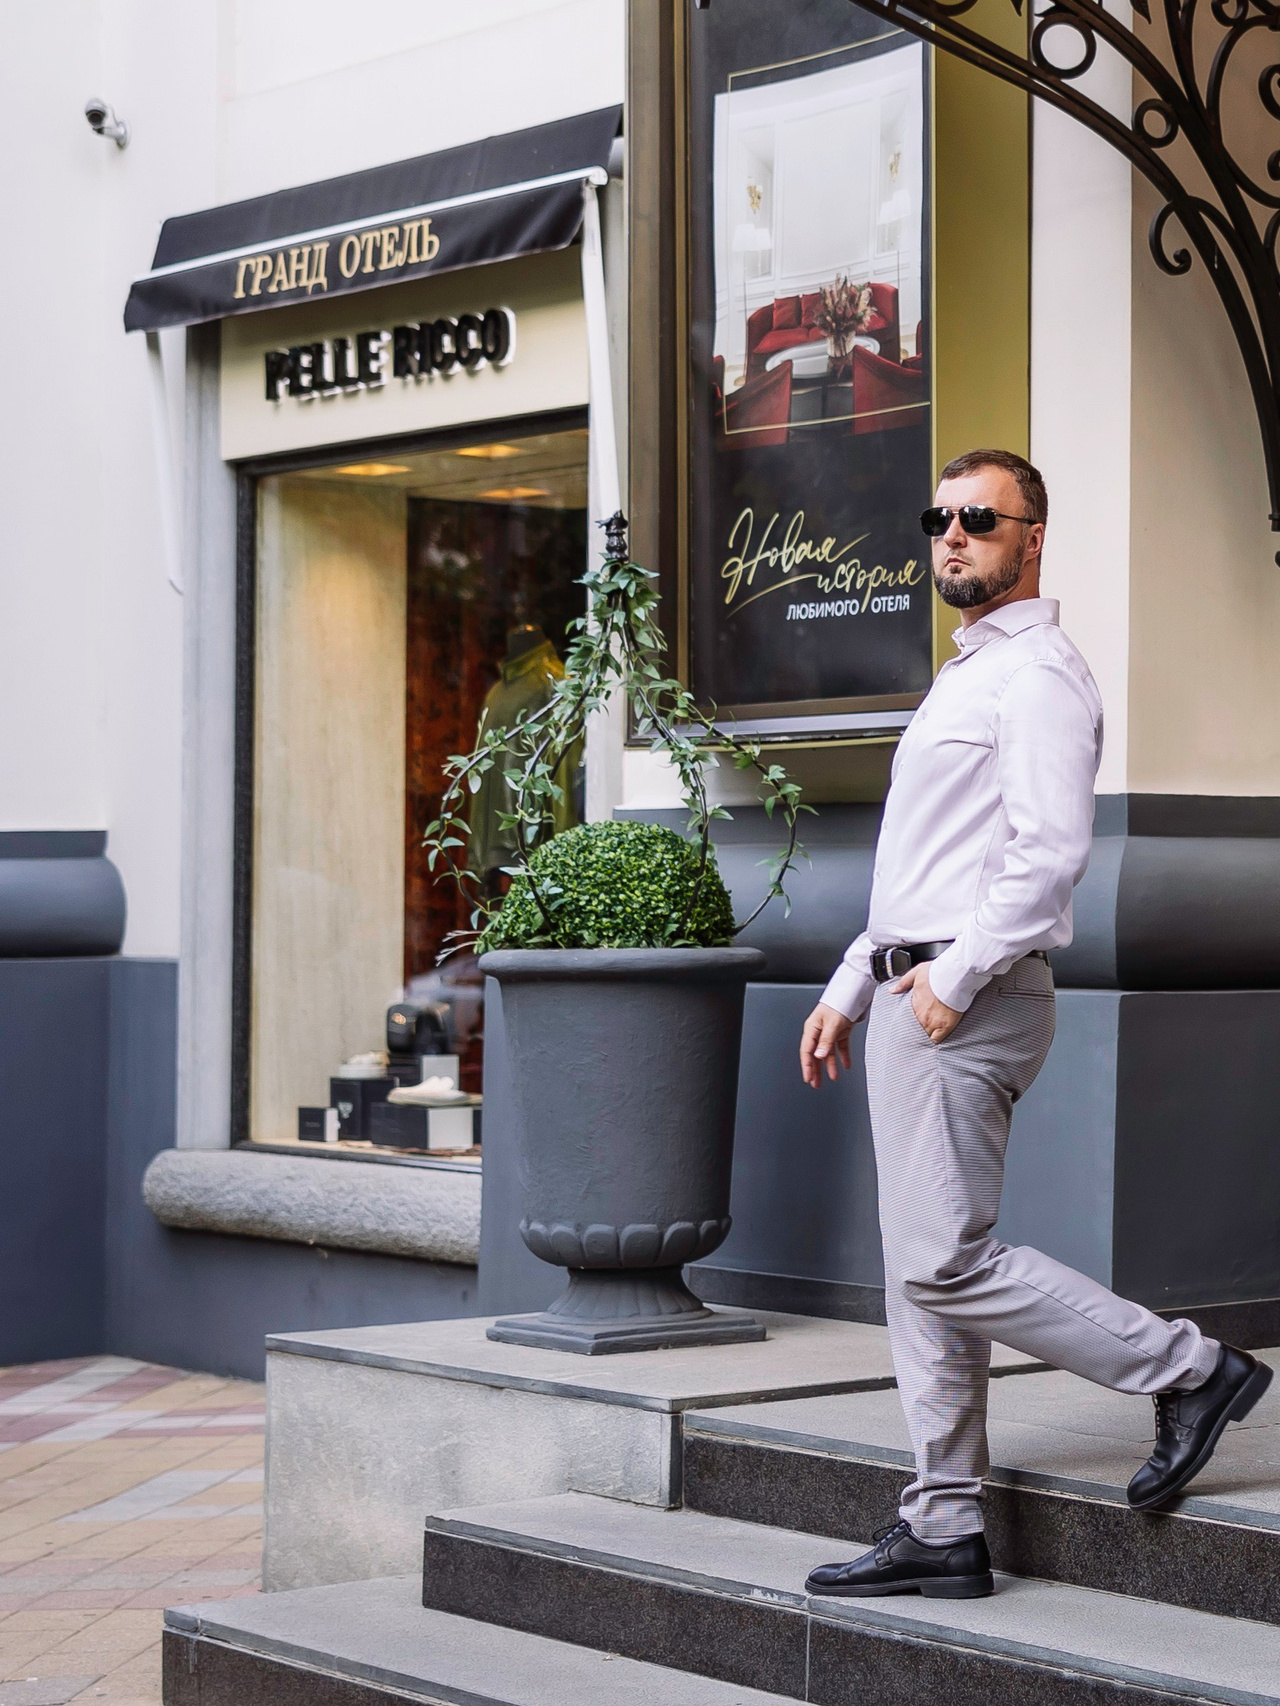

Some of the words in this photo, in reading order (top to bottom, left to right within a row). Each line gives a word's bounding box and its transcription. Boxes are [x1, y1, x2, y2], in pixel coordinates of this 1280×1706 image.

[233, 240, 330, 299] ГРАНД
[338, 217, 441, 279] ОТЕЛЬ
[265, 330, 391, 402] PELLE
[393, 306, 517, 379] RICCO
[721, 507, 871, 604] Новая
[808, 558, 926, 614] история
[786, 598, 860, 621] ЛЮБИМОГО
[871, 594, 911, 614] ОТЕЛЯ
